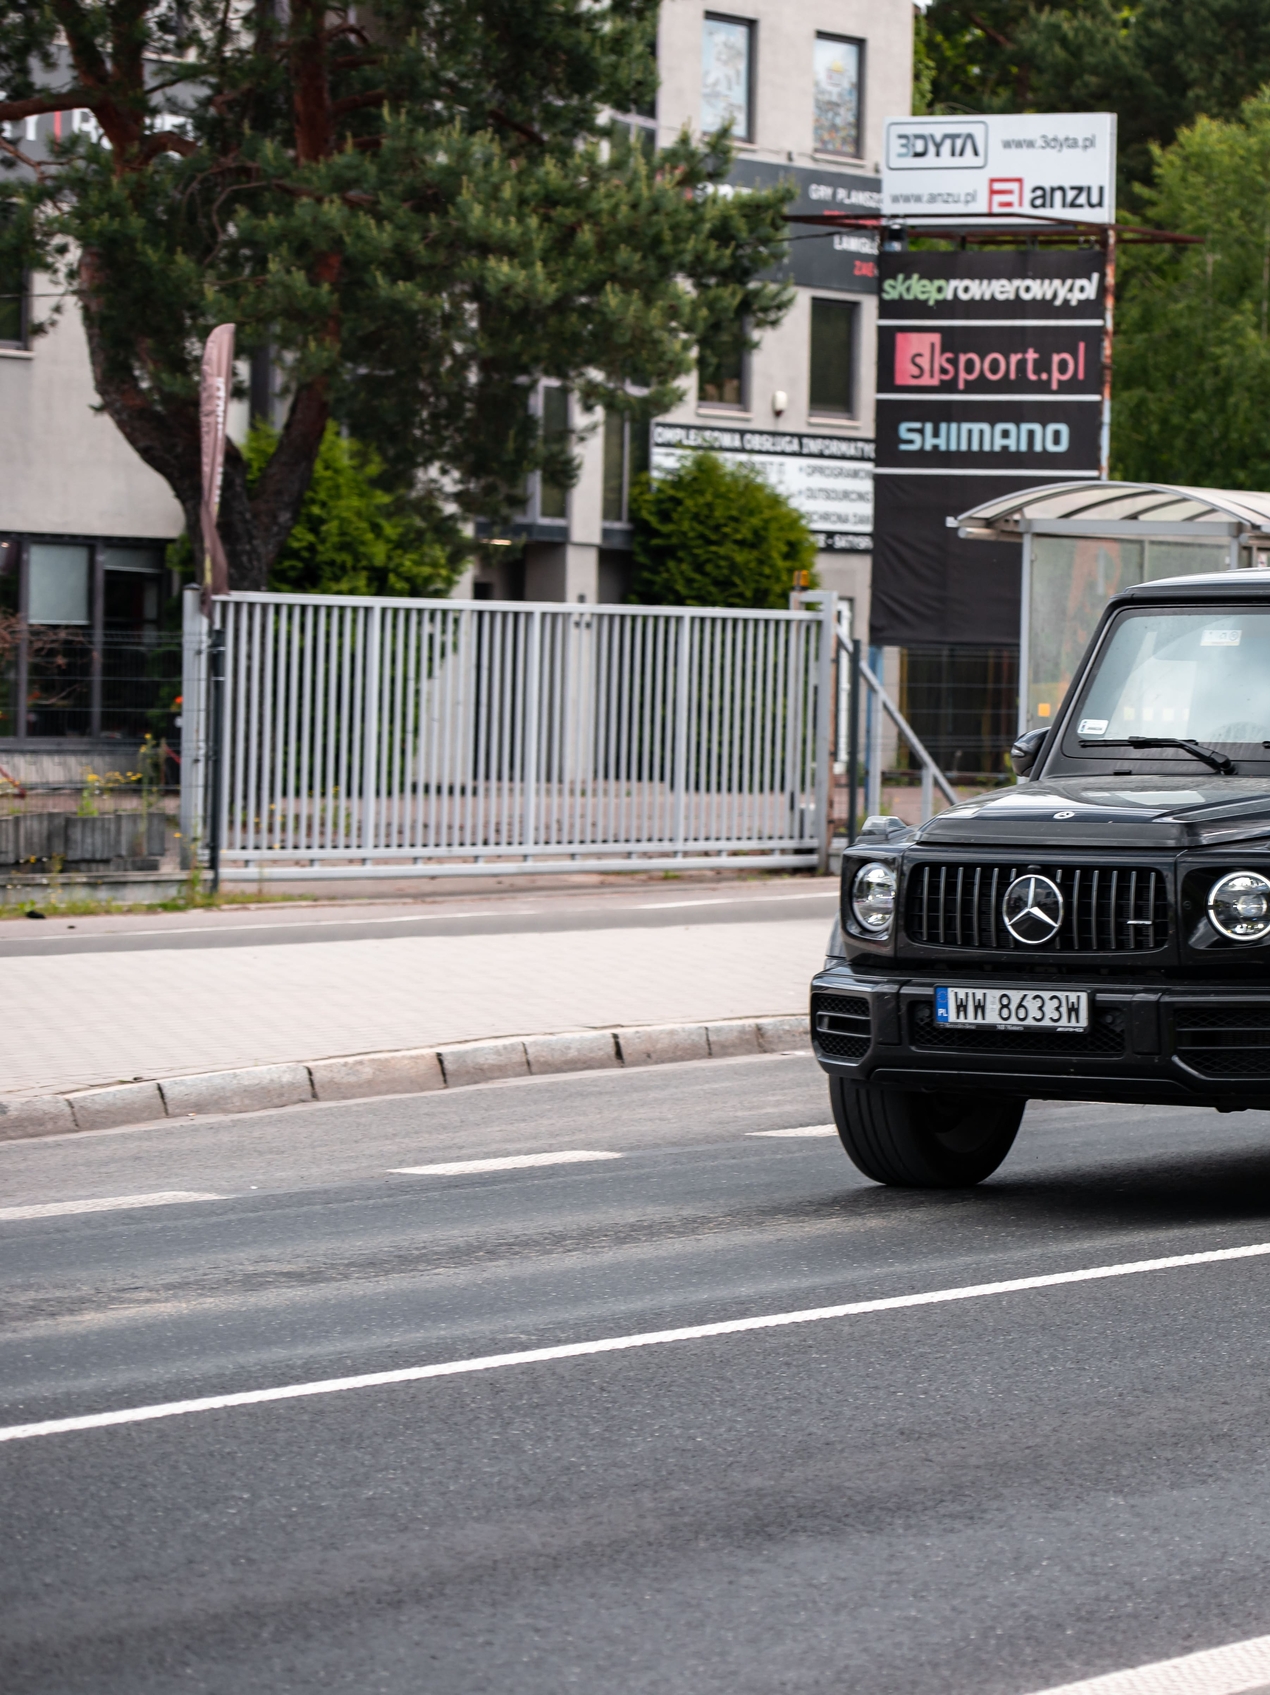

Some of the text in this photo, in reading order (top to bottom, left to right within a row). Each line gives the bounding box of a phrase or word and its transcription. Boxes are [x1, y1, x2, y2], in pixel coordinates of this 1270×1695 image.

[896, 132, 980, 157] 3DYTA
[1001, 134, 1097, 152] www.3dyta.pl
[808, 183, 833, 201] GRY
[890, 189, 978, 206] www.anzu.pl
[1030, 184, 1104, 209] anzu
[881, 271, 1100, 306] skleprowerowy.pl
[910, 341, 1086, 390] slsport.pl
[897, 421, 1070, 452] SHIMANO
[937, 1008, 949, 1017] PL
[954, 991, 1081, 1024] WW 8633W
